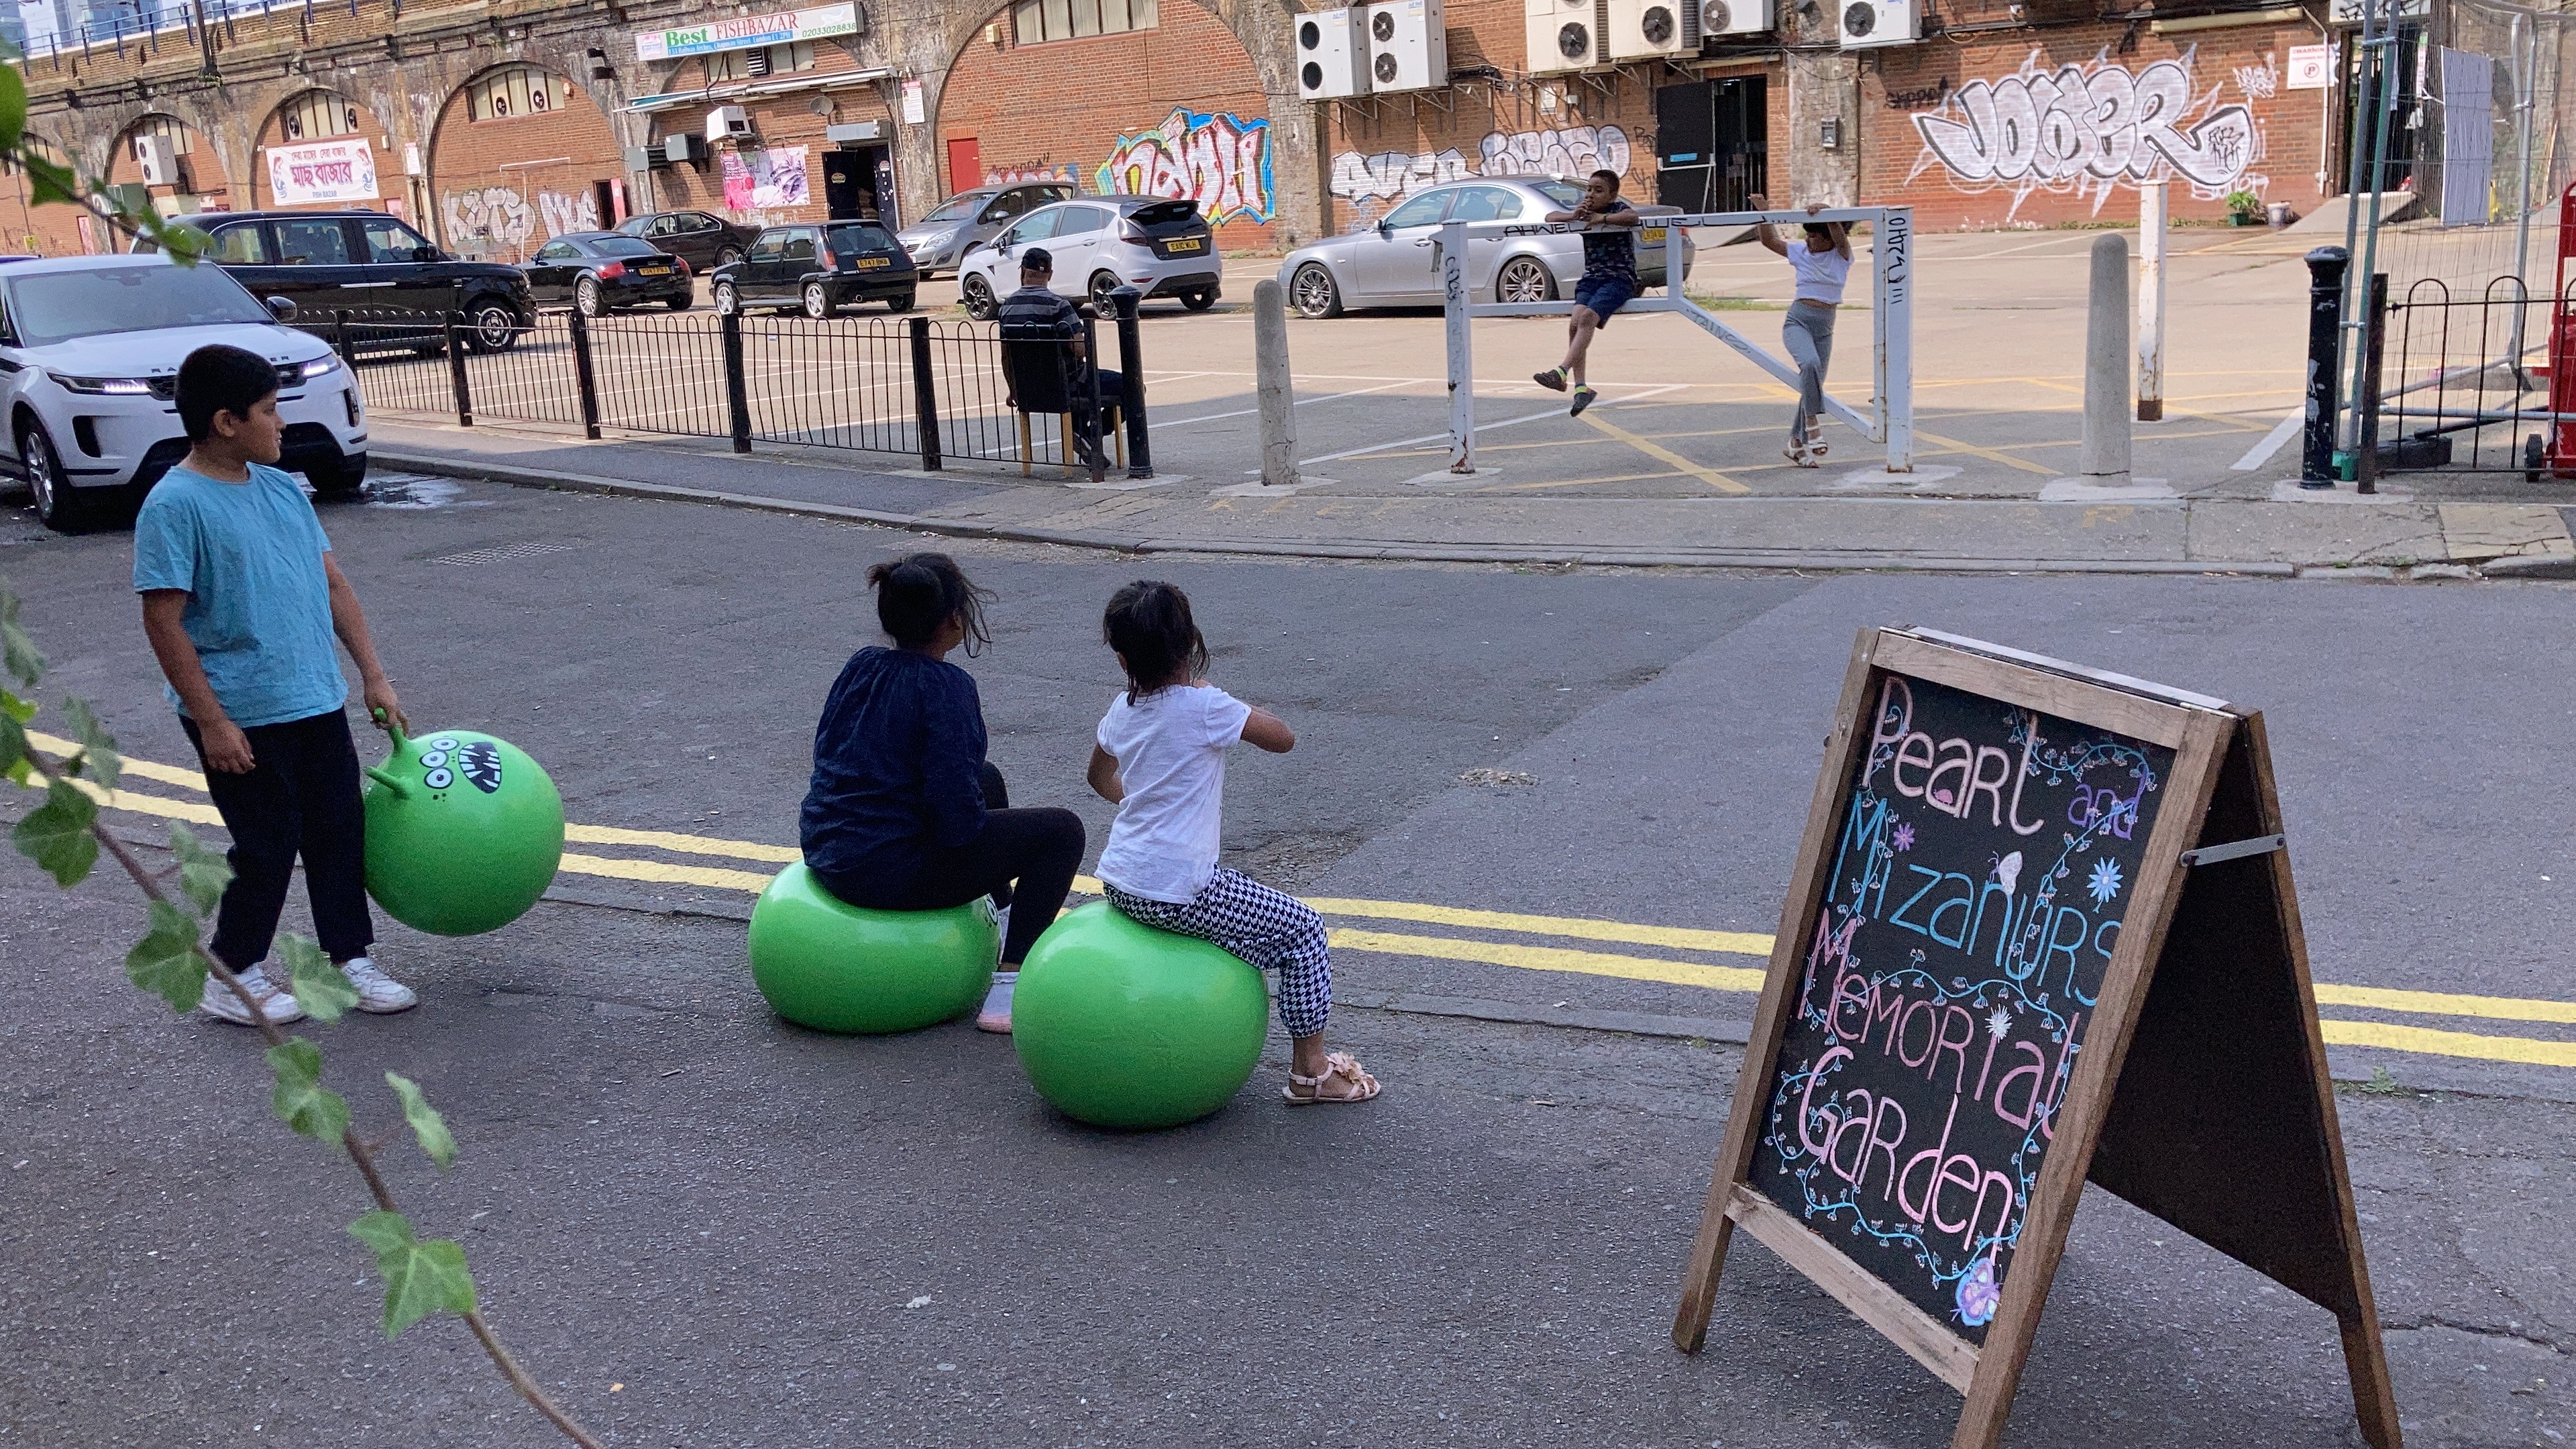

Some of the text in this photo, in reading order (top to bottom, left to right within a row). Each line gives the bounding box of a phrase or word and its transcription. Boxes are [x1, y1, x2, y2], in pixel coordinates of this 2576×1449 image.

[665, 13, 799, 47] Best FISHBAZAR
[753, 35, 771, 44] London
[290, 159, 354, 189] মাছ বাজার
[2068, 766, 2148, 842] and
